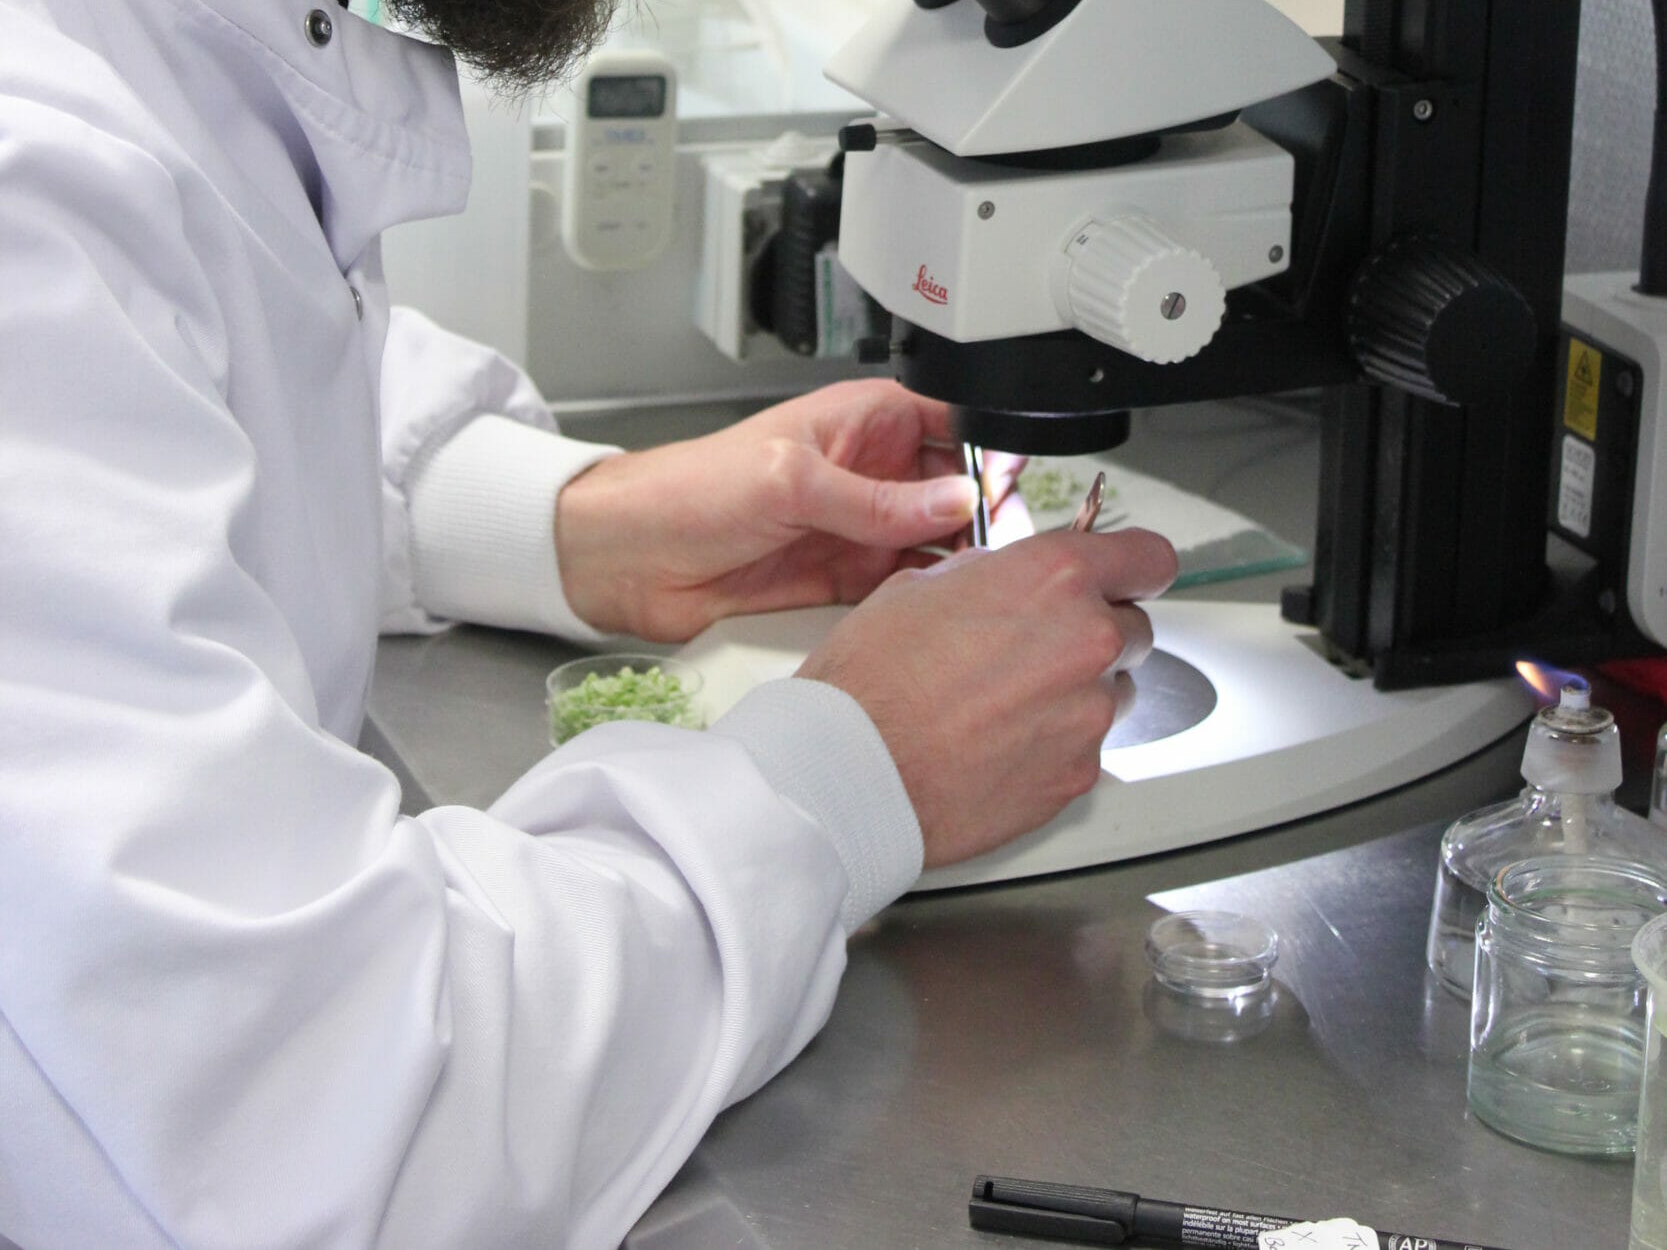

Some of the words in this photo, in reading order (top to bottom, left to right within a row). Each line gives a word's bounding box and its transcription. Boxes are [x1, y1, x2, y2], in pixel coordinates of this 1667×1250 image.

[912, 263, 948, 305] Leica
[1183, 1212, 1221, 1224] waterproof
[1232, 1218, 1249, 1227] most
[1250, 1220, 1276, 1230] surfaces
